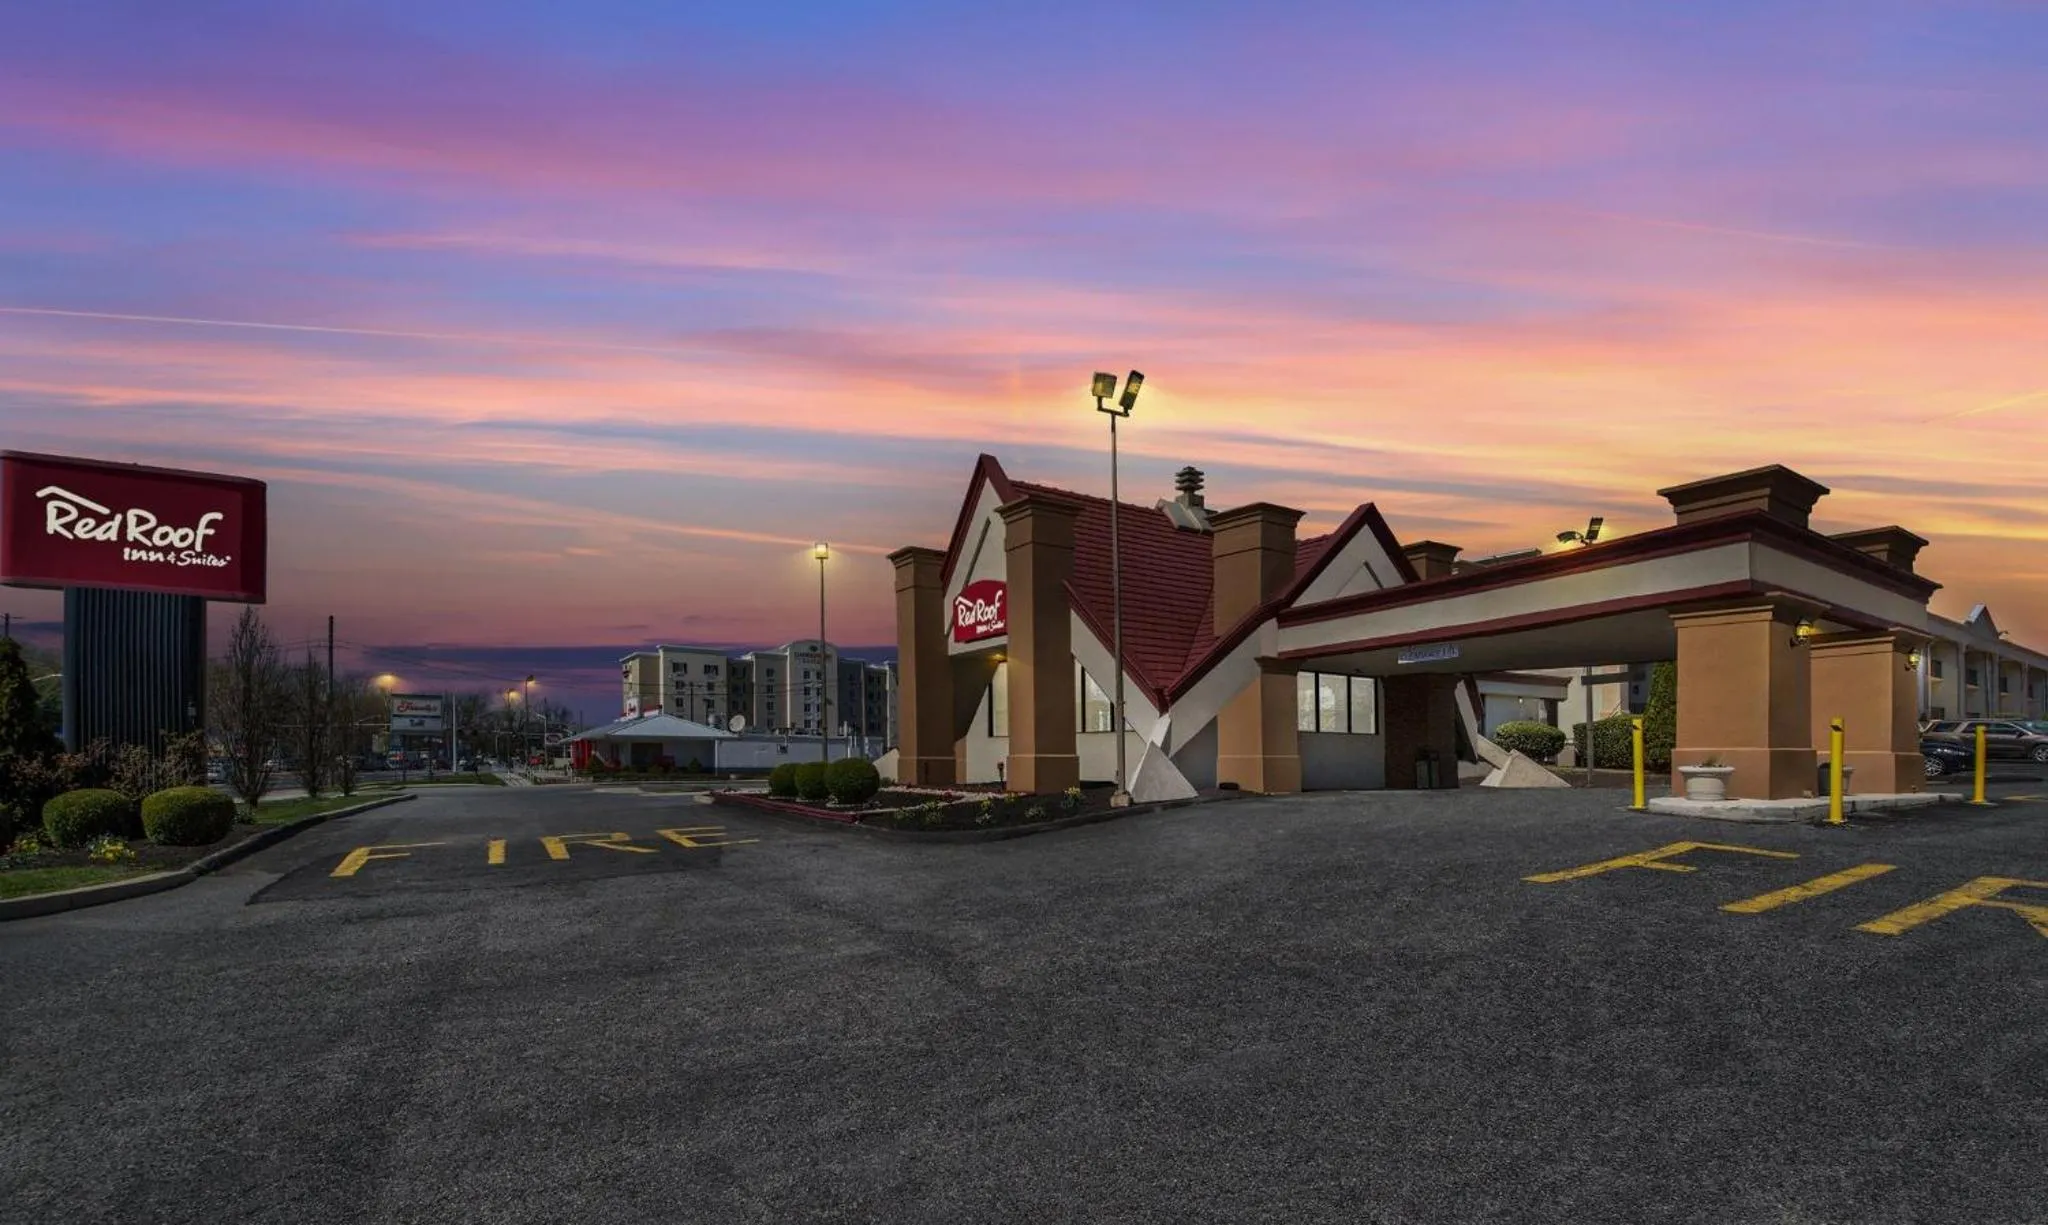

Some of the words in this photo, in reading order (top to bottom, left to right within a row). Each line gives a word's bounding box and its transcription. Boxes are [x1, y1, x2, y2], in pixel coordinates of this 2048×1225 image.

[45, 500, 123, 541] Red
[126, 508, 223, 552] Roof
[176, 550, 231, 567] Suites
[957, 604, 977, 627] Red
[976, 590, 1003, 622] Roof
[328, 826, 761, 878] FIRE
